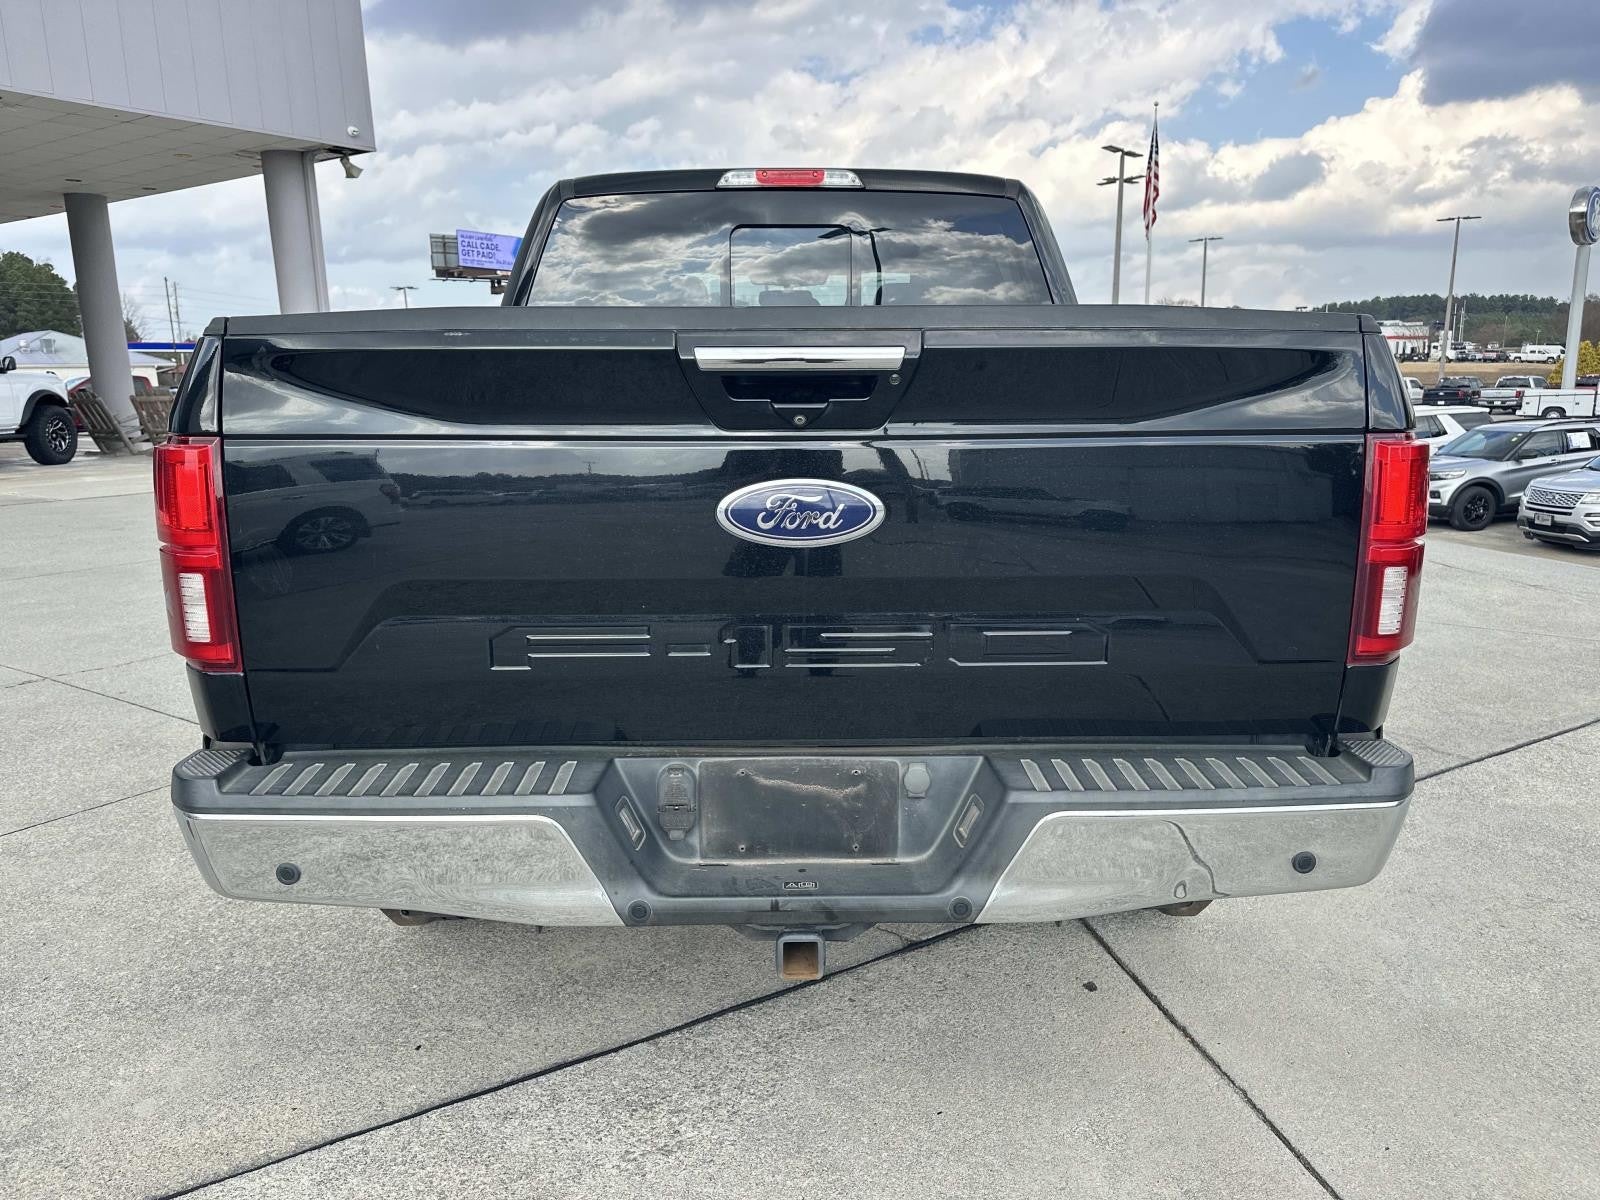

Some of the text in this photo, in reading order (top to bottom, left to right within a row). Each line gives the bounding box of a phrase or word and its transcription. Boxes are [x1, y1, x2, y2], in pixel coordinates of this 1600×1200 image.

[460, 240, 479, 249] CALL
[461, 248, 475, 257] GET
[756, 493, 847, 531] Ford
[488, 623, 1110, 670] F-150
